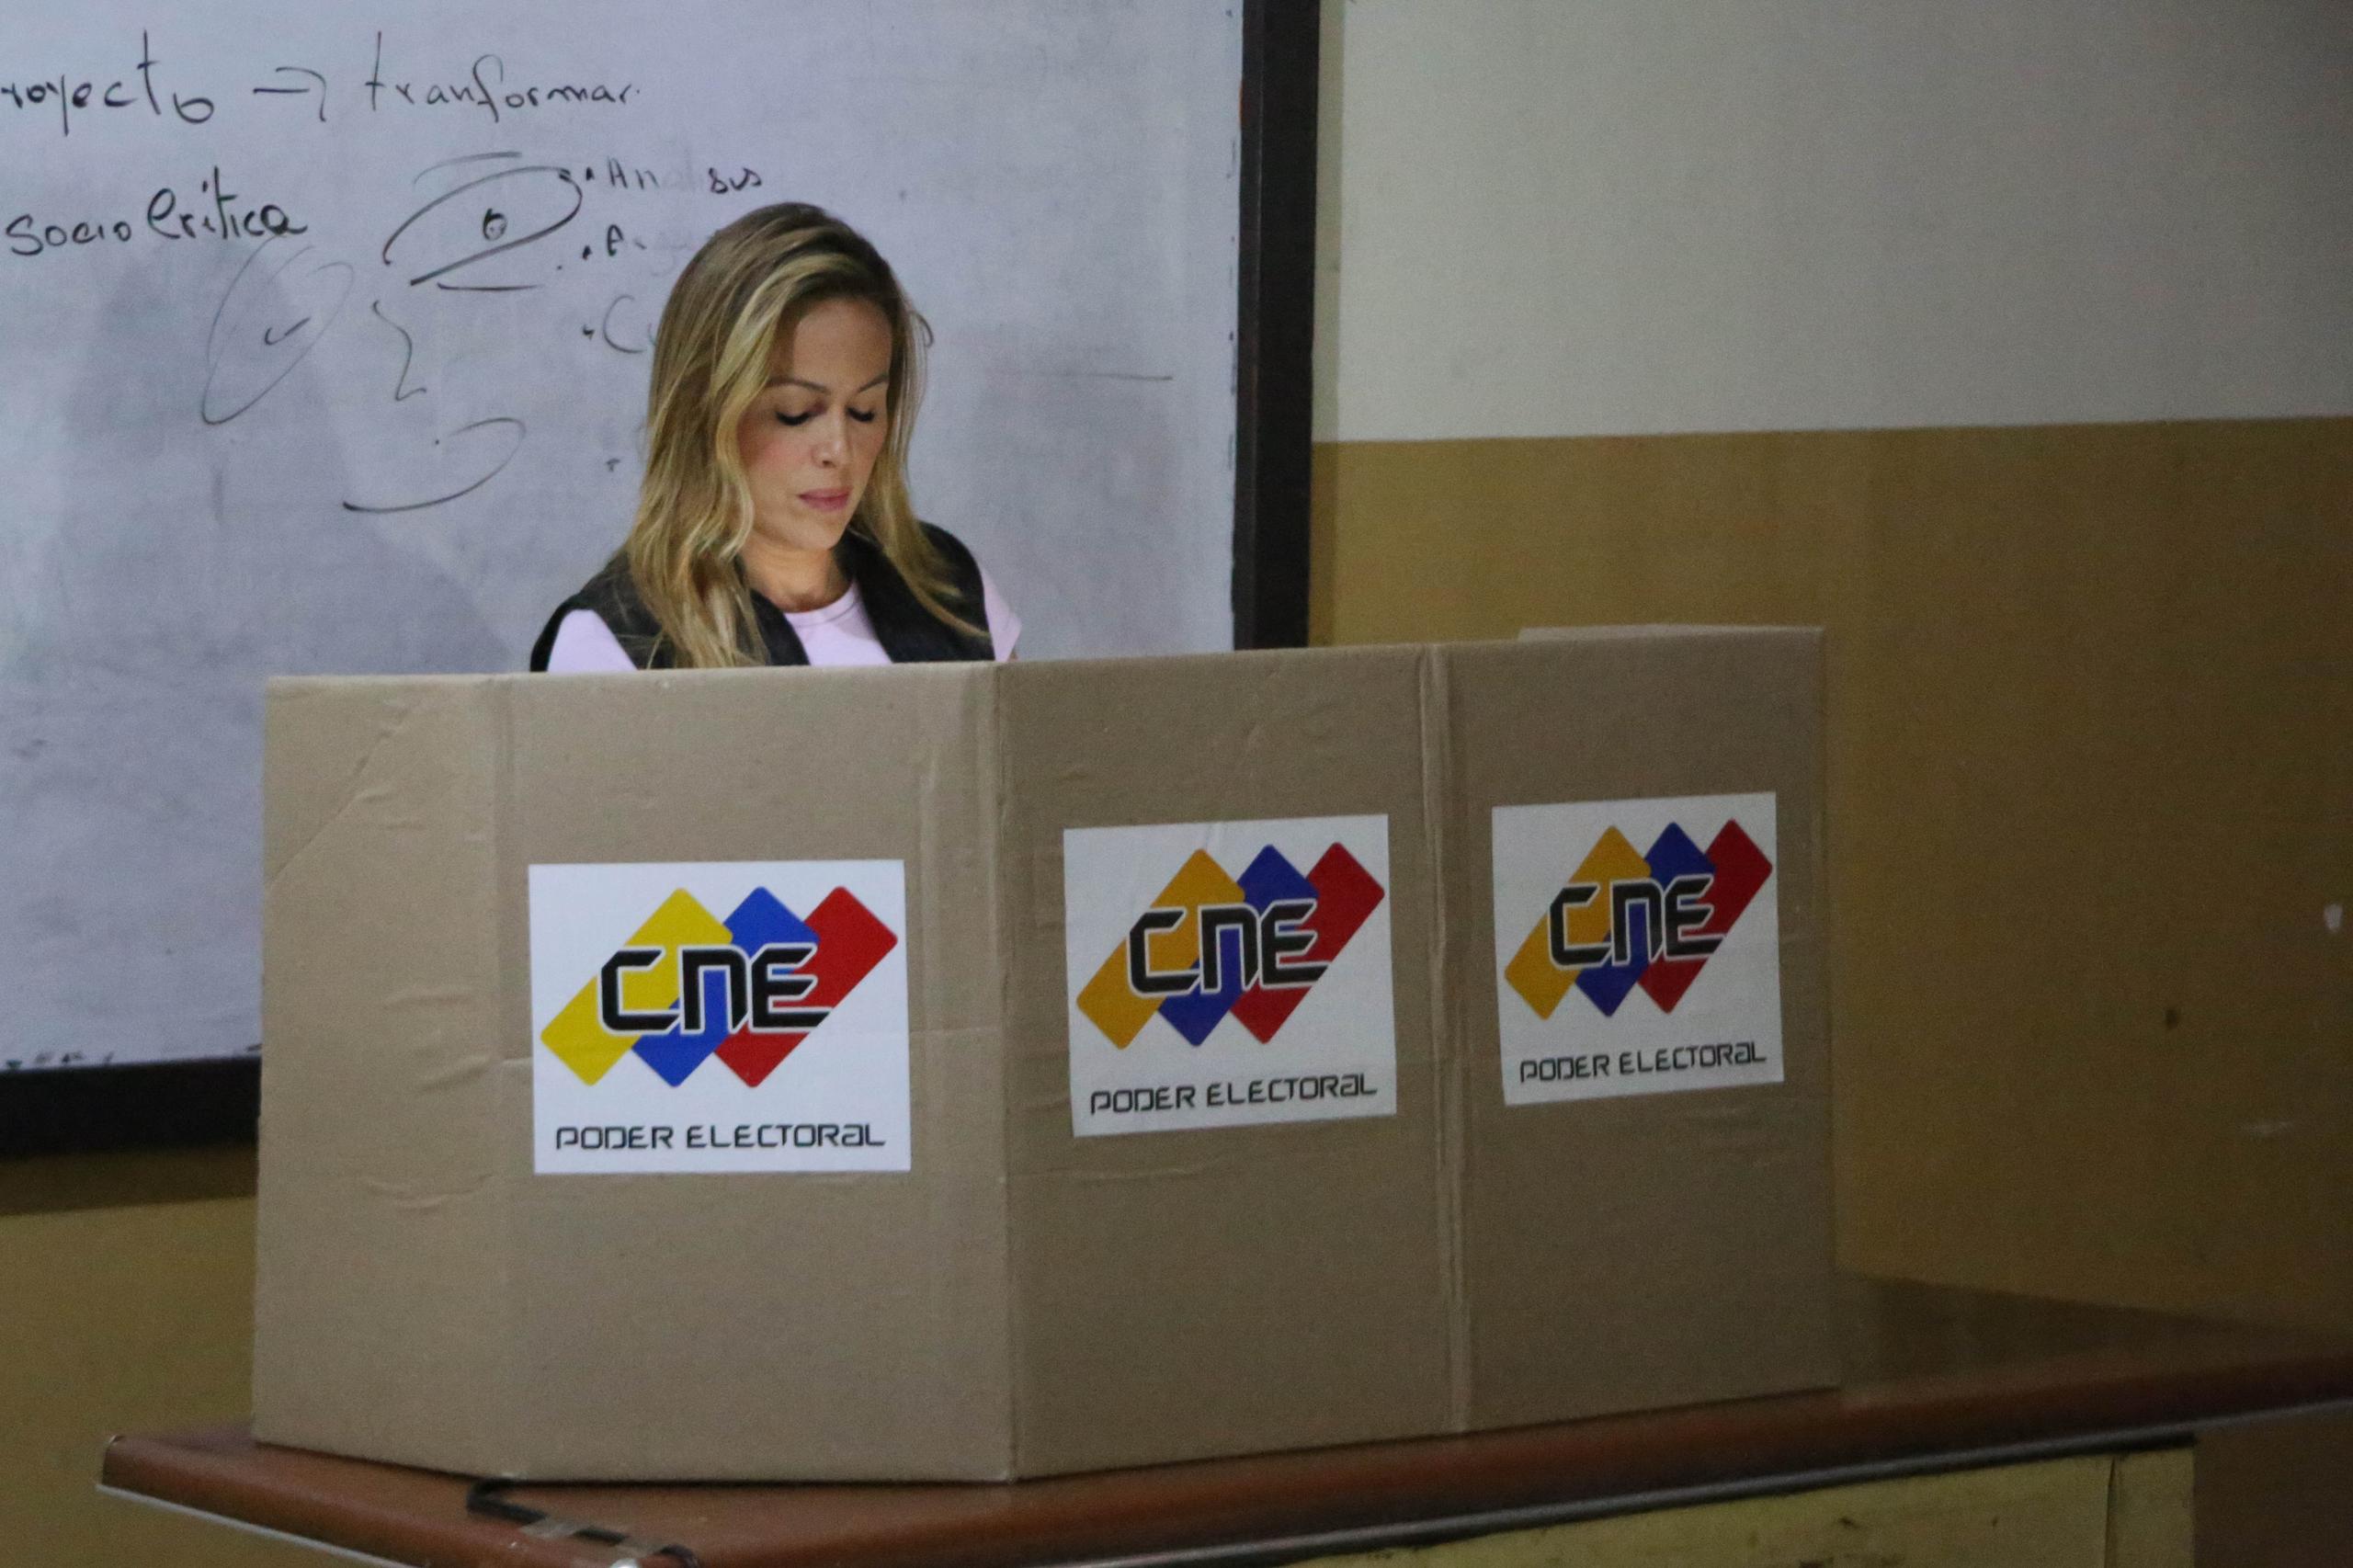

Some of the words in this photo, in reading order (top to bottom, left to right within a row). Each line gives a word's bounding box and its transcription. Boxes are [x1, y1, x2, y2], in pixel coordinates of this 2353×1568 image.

[1129, 901, 1329, 994] CNE
[1550, 876, 1724, 966] CNE
[600, 946, 831, 1031] CNE
[1520, 1055, 1610, 1084] PODER
[1090, 1085, 1196, 1116] PODER
[556, 1126, 675, 1150] PODER
